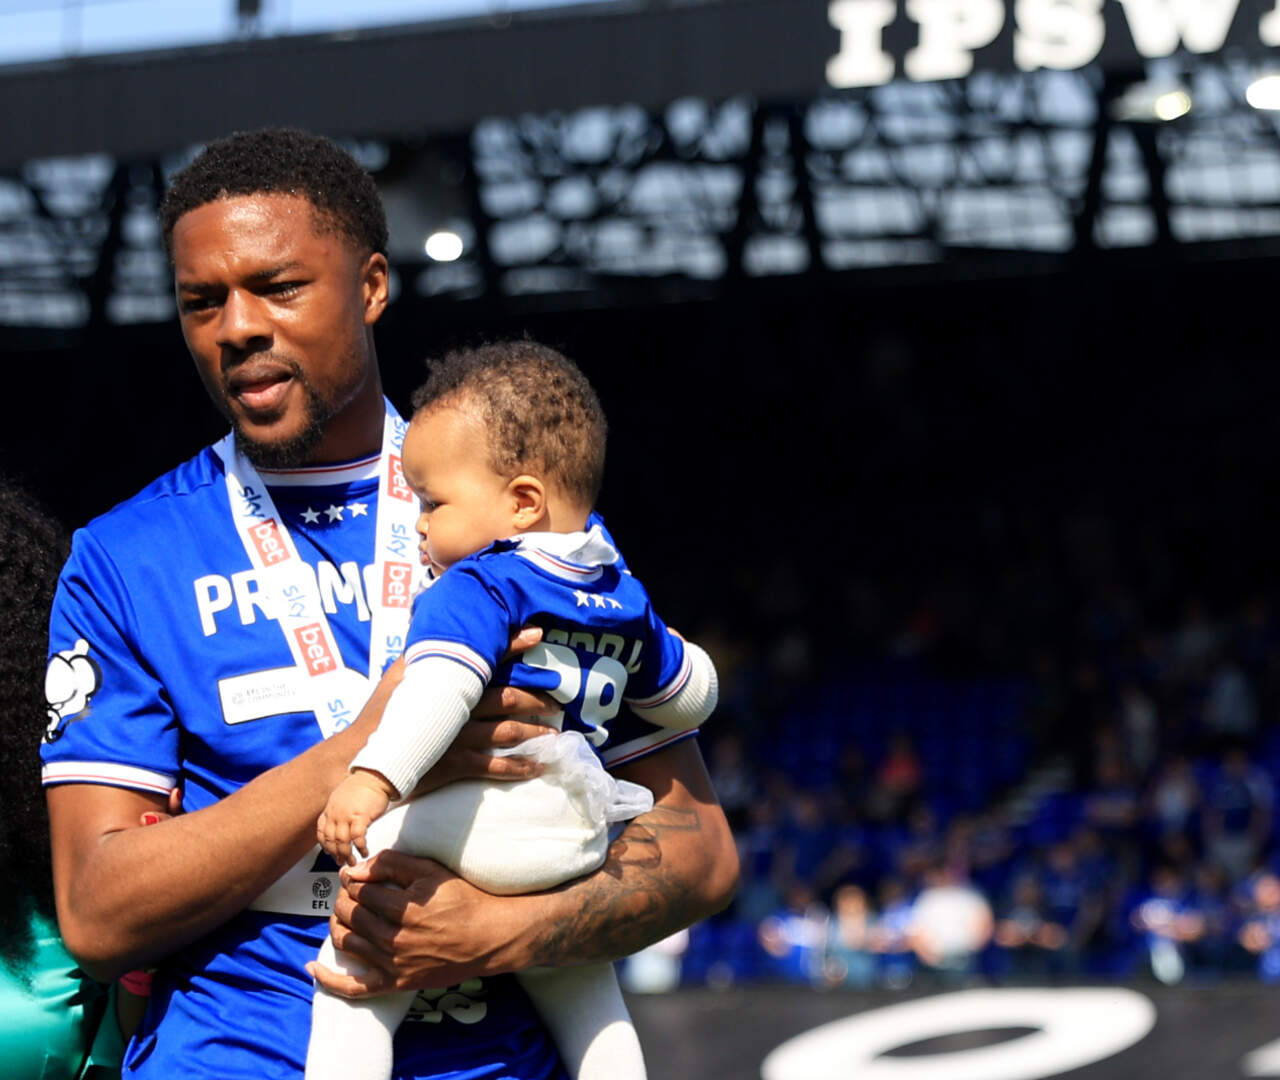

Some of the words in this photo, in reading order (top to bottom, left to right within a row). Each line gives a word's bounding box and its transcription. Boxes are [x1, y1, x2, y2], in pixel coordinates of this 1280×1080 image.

[239, 486, 266, 518] sky
[253, 520, 285, 563] bet
[386, 523, 412, 558] sky
[388, 565, 411, 607] bet
[282, 585, 311, 618] sky
[300, 626, 332, 672] bet
[386, 635, 403, 666] sk
[327, 698, 352, 735] sk
[312, 900, 330, 910] EFL
